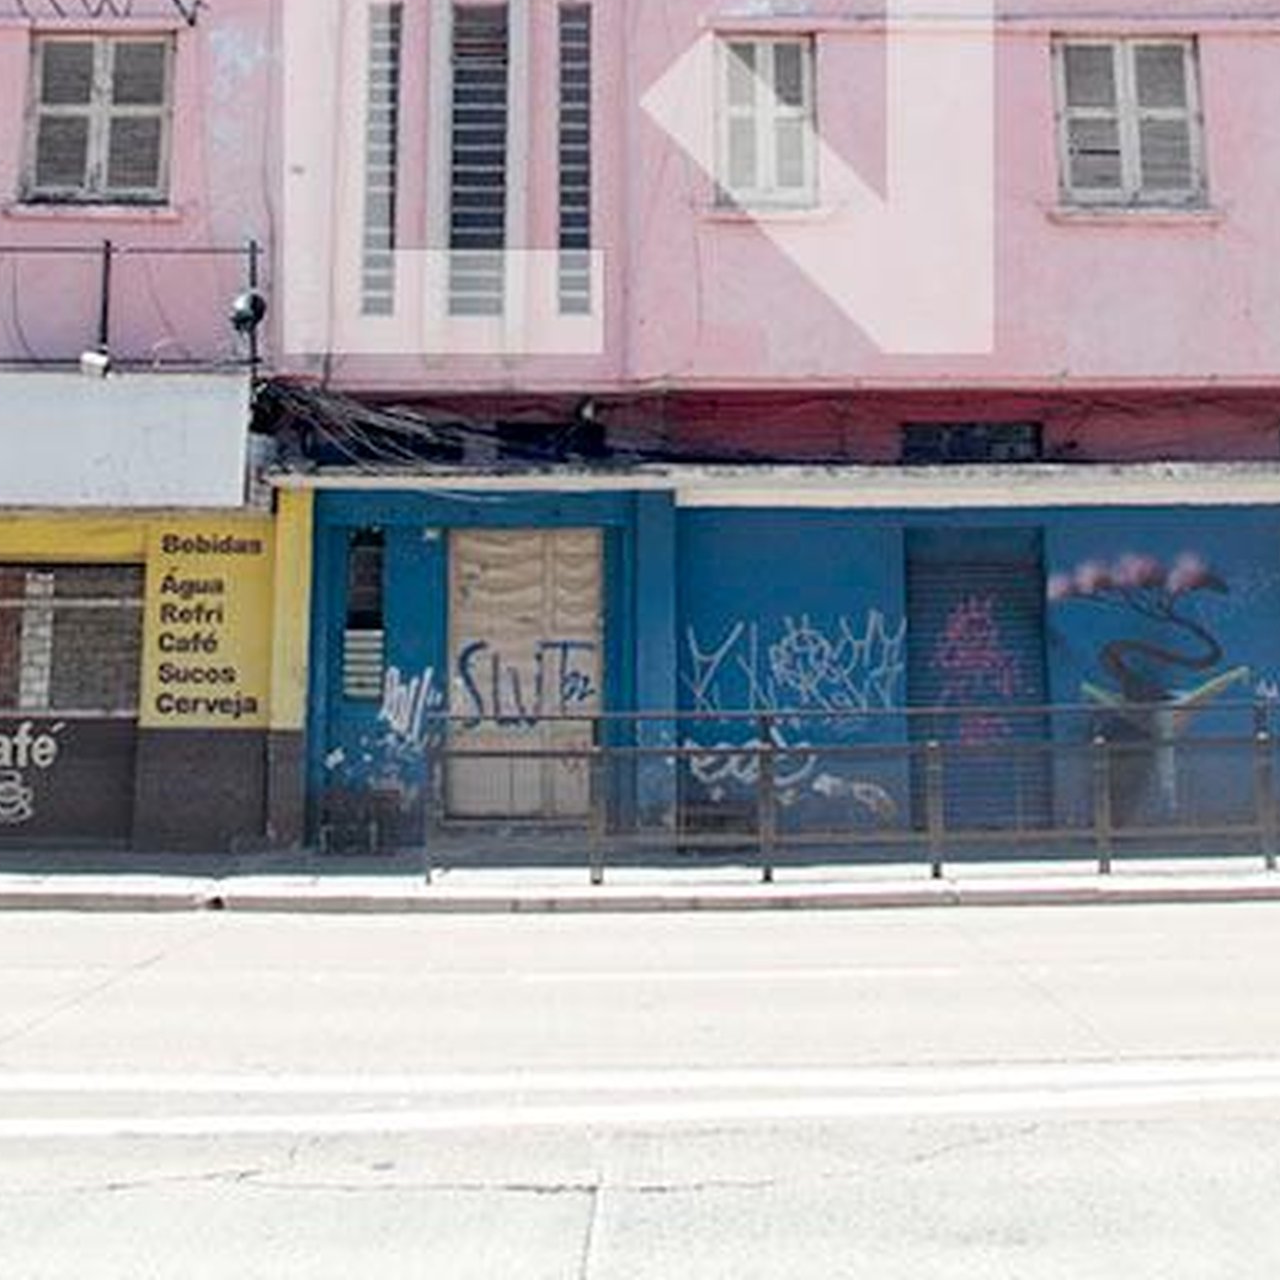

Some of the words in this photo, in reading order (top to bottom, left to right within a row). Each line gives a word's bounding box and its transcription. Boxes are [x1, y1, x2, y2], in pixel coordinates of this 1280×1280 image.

[161, 534, 263, 555] Bebidas
[160, 567, 224, 599] Água
[160, 603, 224, 625] Refri
[158, 632, 218, 654] Café
[158, 662, 237, 684] Sucos
[155, 690, 258, 719] Cerveja
